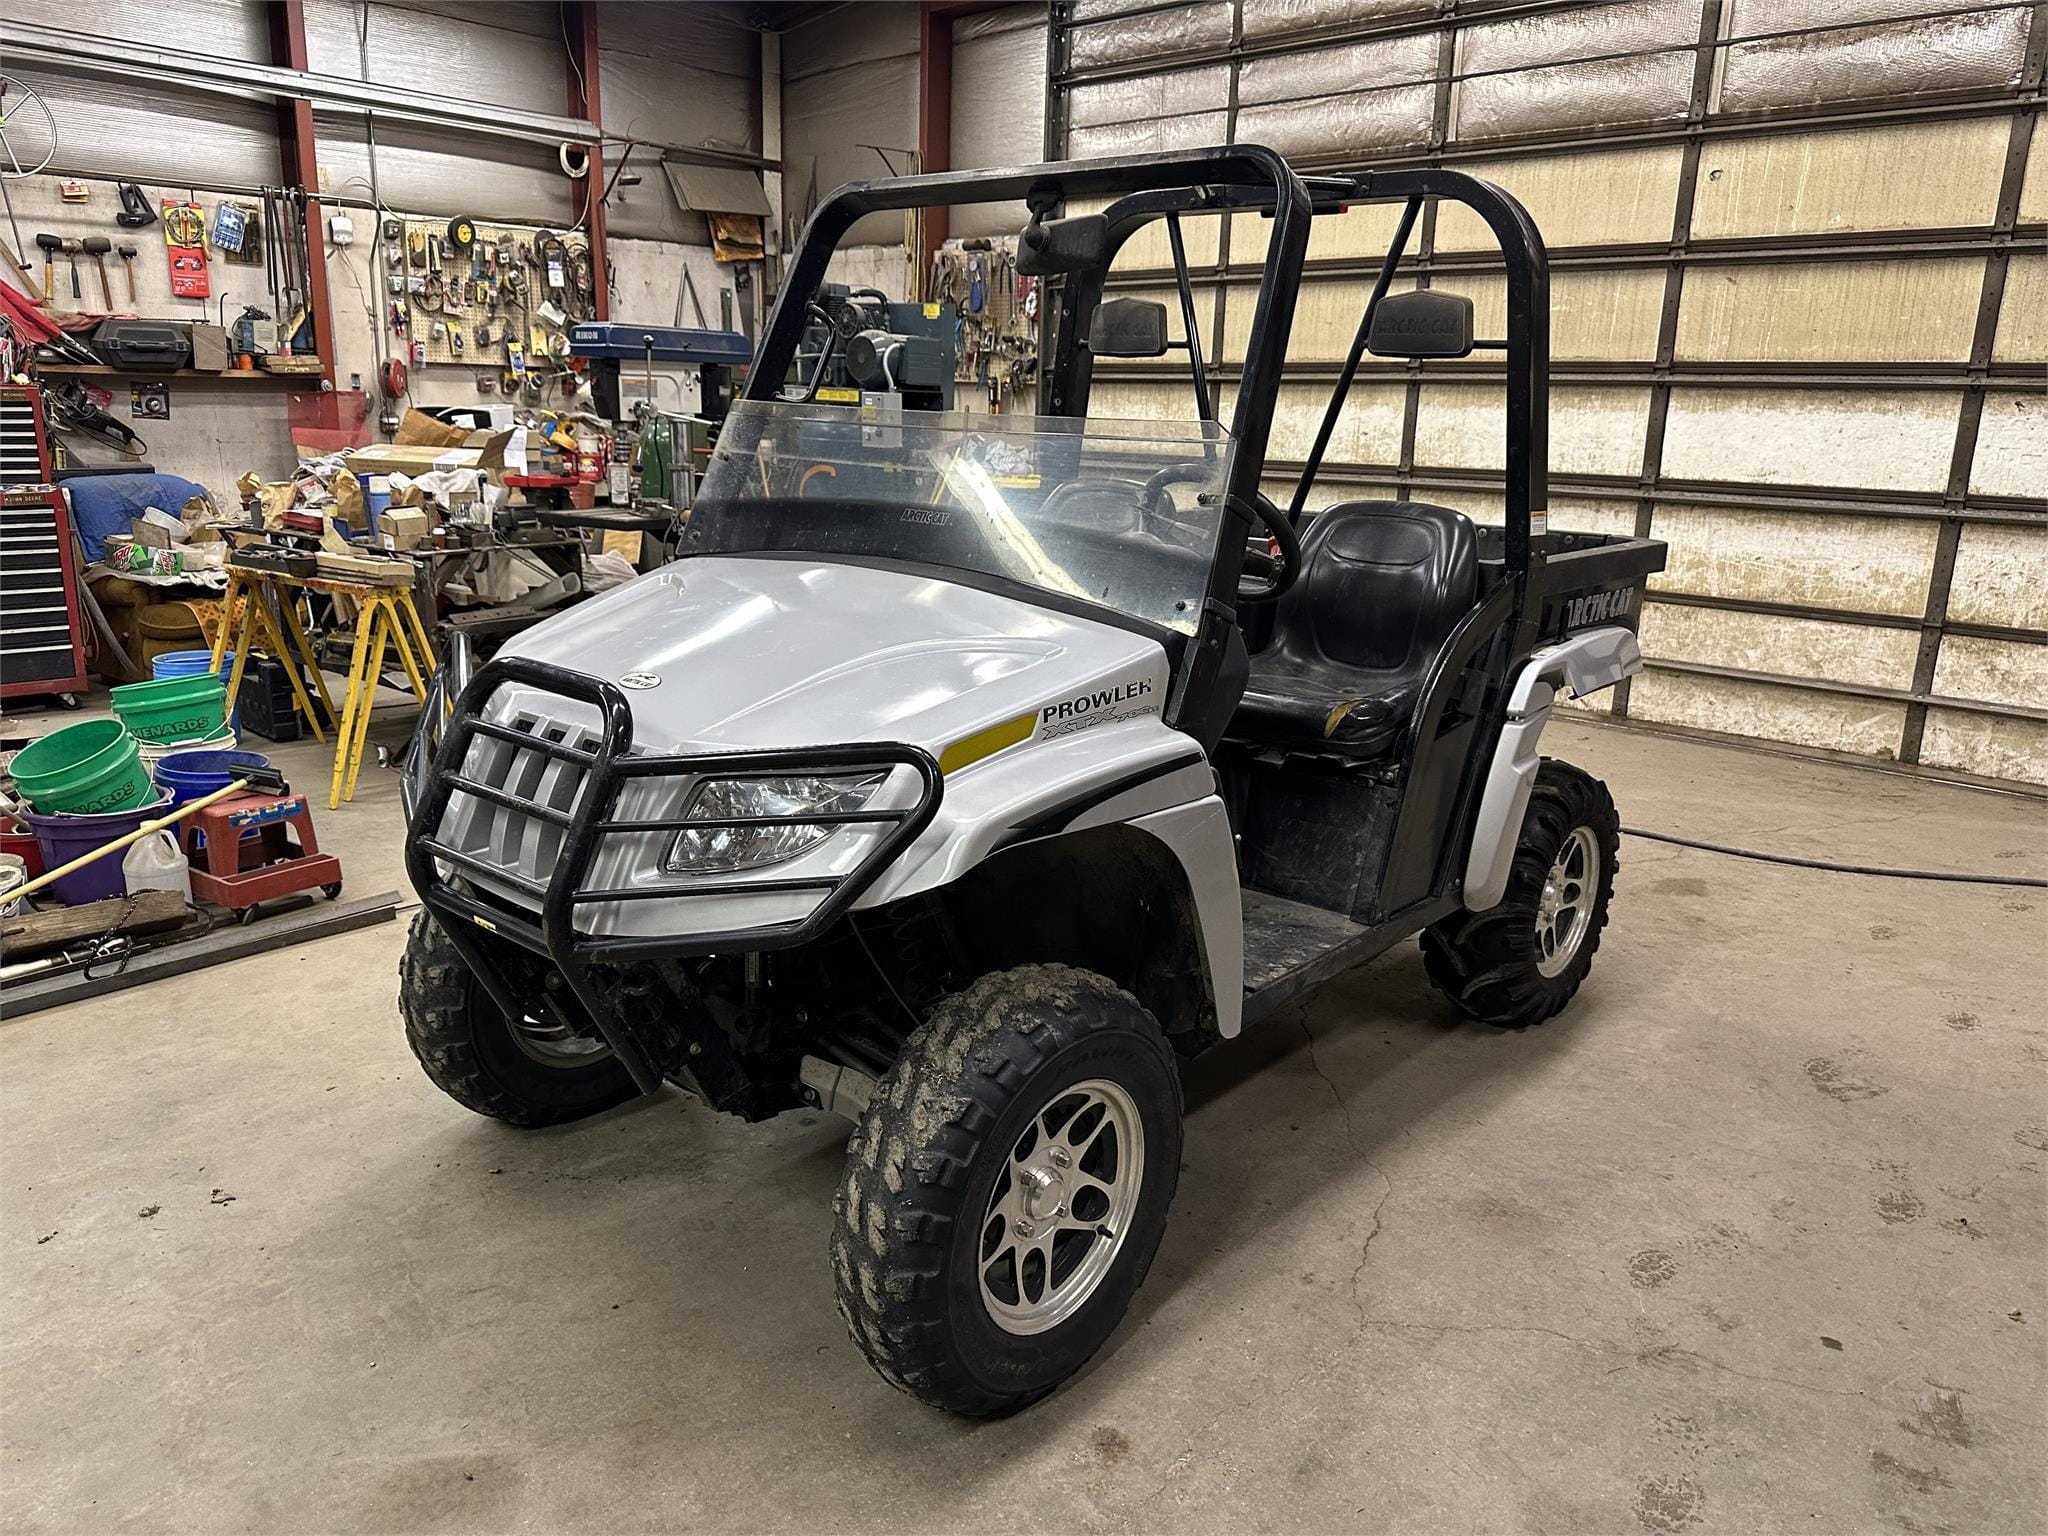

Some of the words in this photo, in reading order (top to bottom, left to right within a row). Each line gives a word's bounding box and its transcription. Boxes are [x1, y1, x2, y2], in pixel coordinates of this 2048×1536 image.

[900, 508, 933, 524] ARCTIC
[931, 511, 951, 526] CAT
[1609, 587, 1634, 618] CAT
[1042, 677, 1152, 723] PROWLER
[130, 716, 210, 740] MENARDS
[1042, 706, 1118, 740] XTX
[58, 780, 135, 814] NARDS
